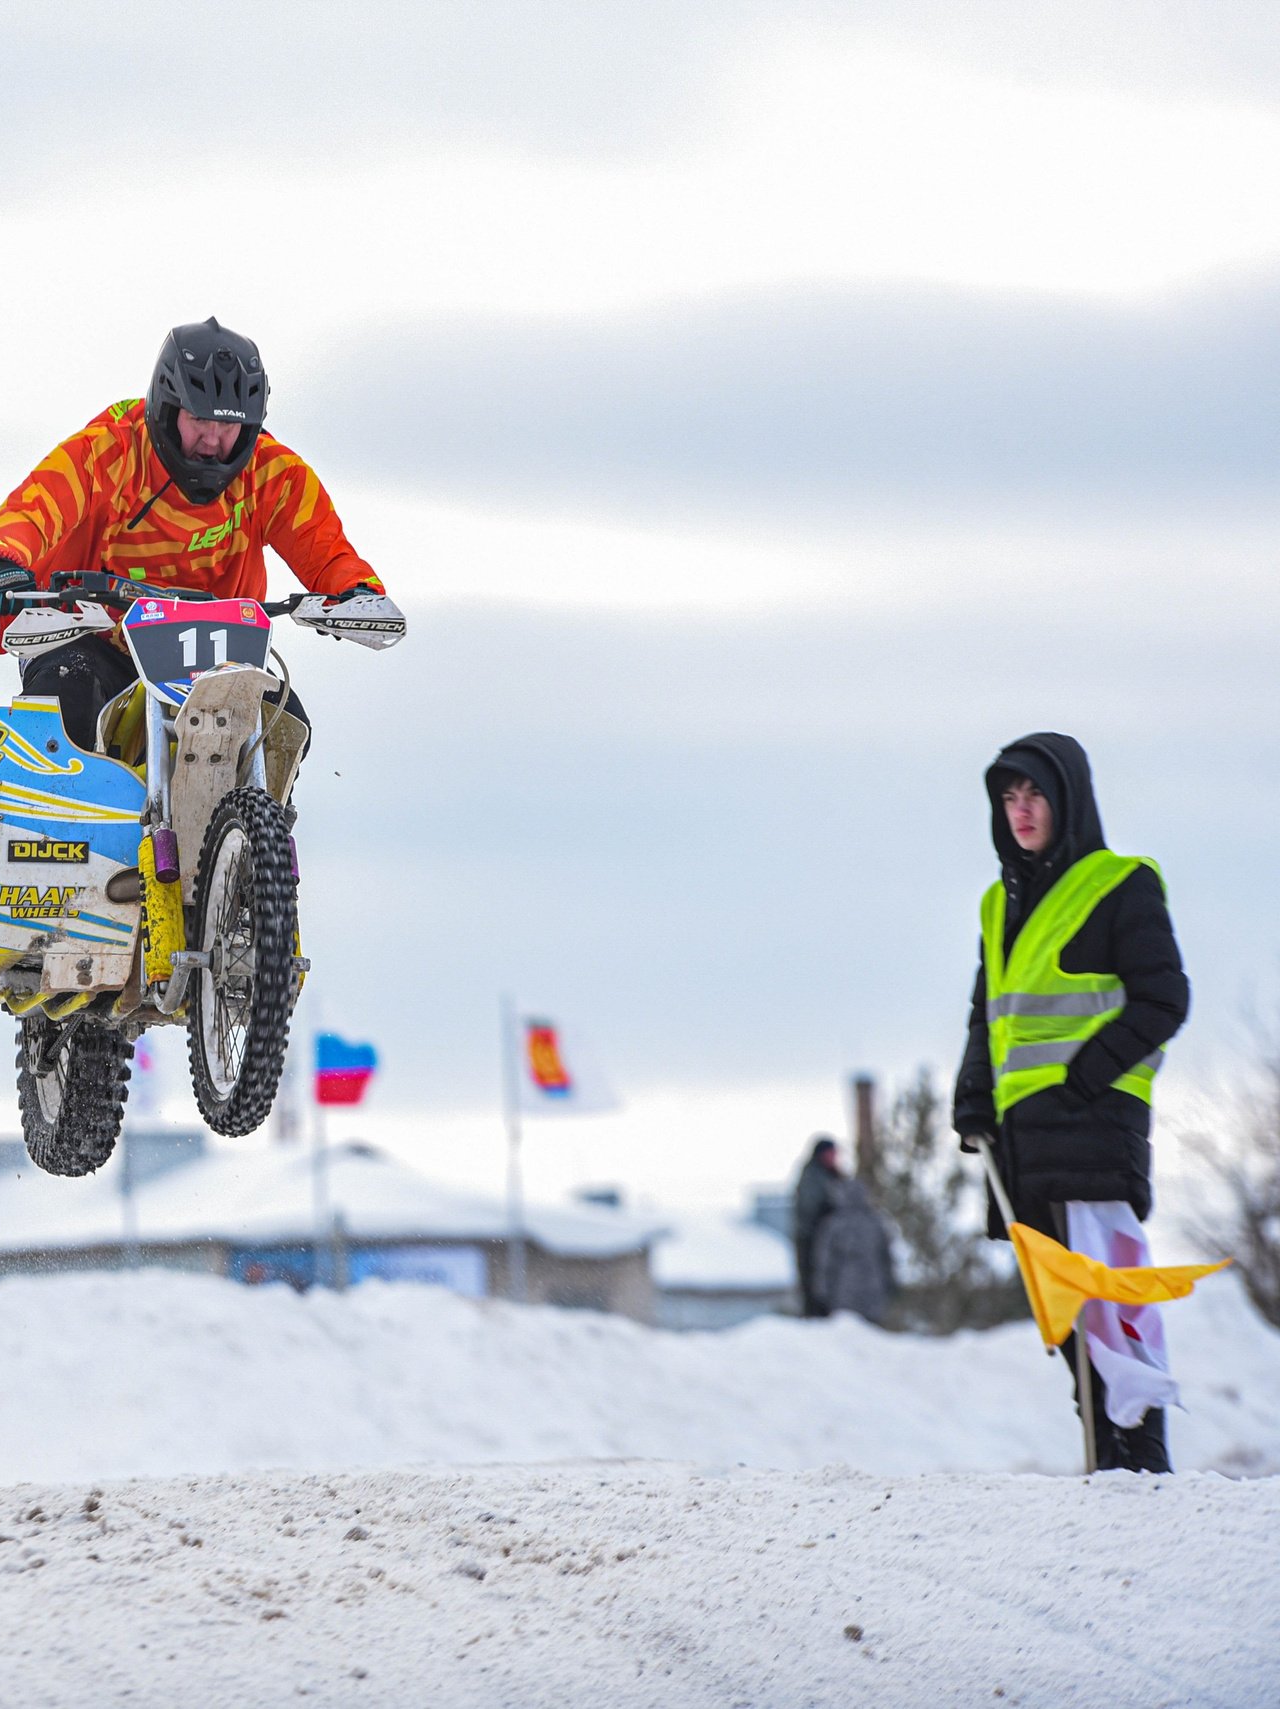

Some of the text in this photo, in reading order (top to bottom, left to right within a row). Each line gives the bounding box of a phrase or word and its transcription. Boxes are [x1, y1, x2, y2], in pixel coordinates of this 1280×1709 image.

[334, 620, 404, 631] RACETECH
[6, 629, 72, 645] RACETECH
[178, 627, 228, 668] 11
[14, 842, 86, 858] DIJCK
